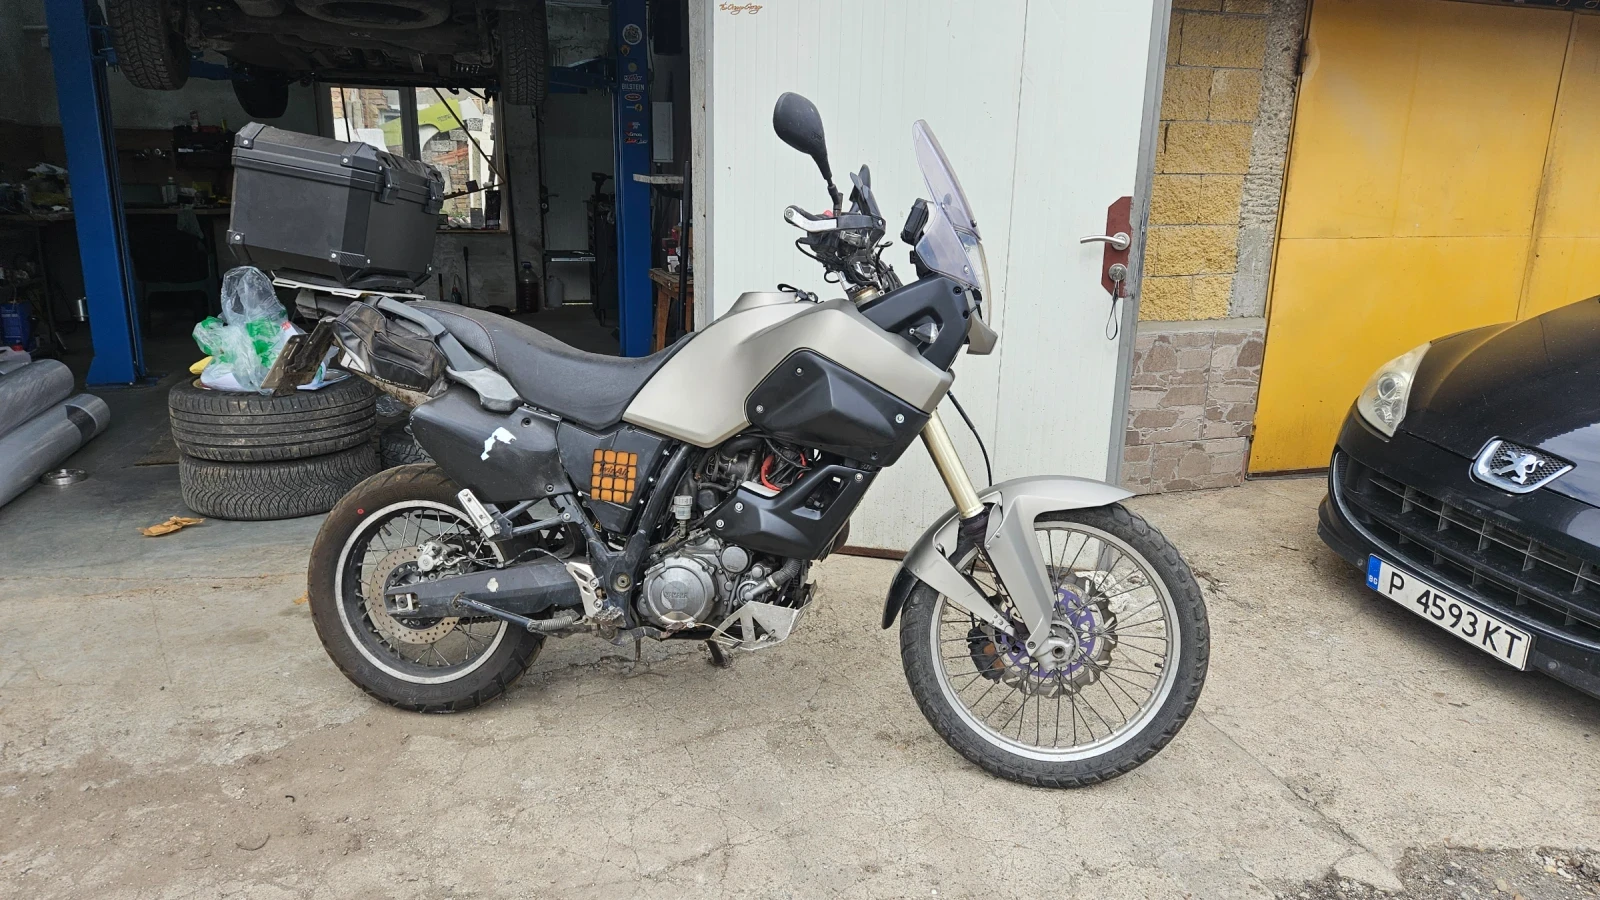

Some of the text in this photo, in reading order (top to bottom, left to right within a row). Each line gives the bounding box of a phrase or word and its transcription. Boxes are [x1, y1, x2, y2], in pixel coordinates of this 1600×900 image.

[621, 83, 645, 91] BILSTEIN
[1368, 574, 1378, 585] BG
[1389, 571, 1405, 595] P
[664, 591, 688, 599] YAMAHA
